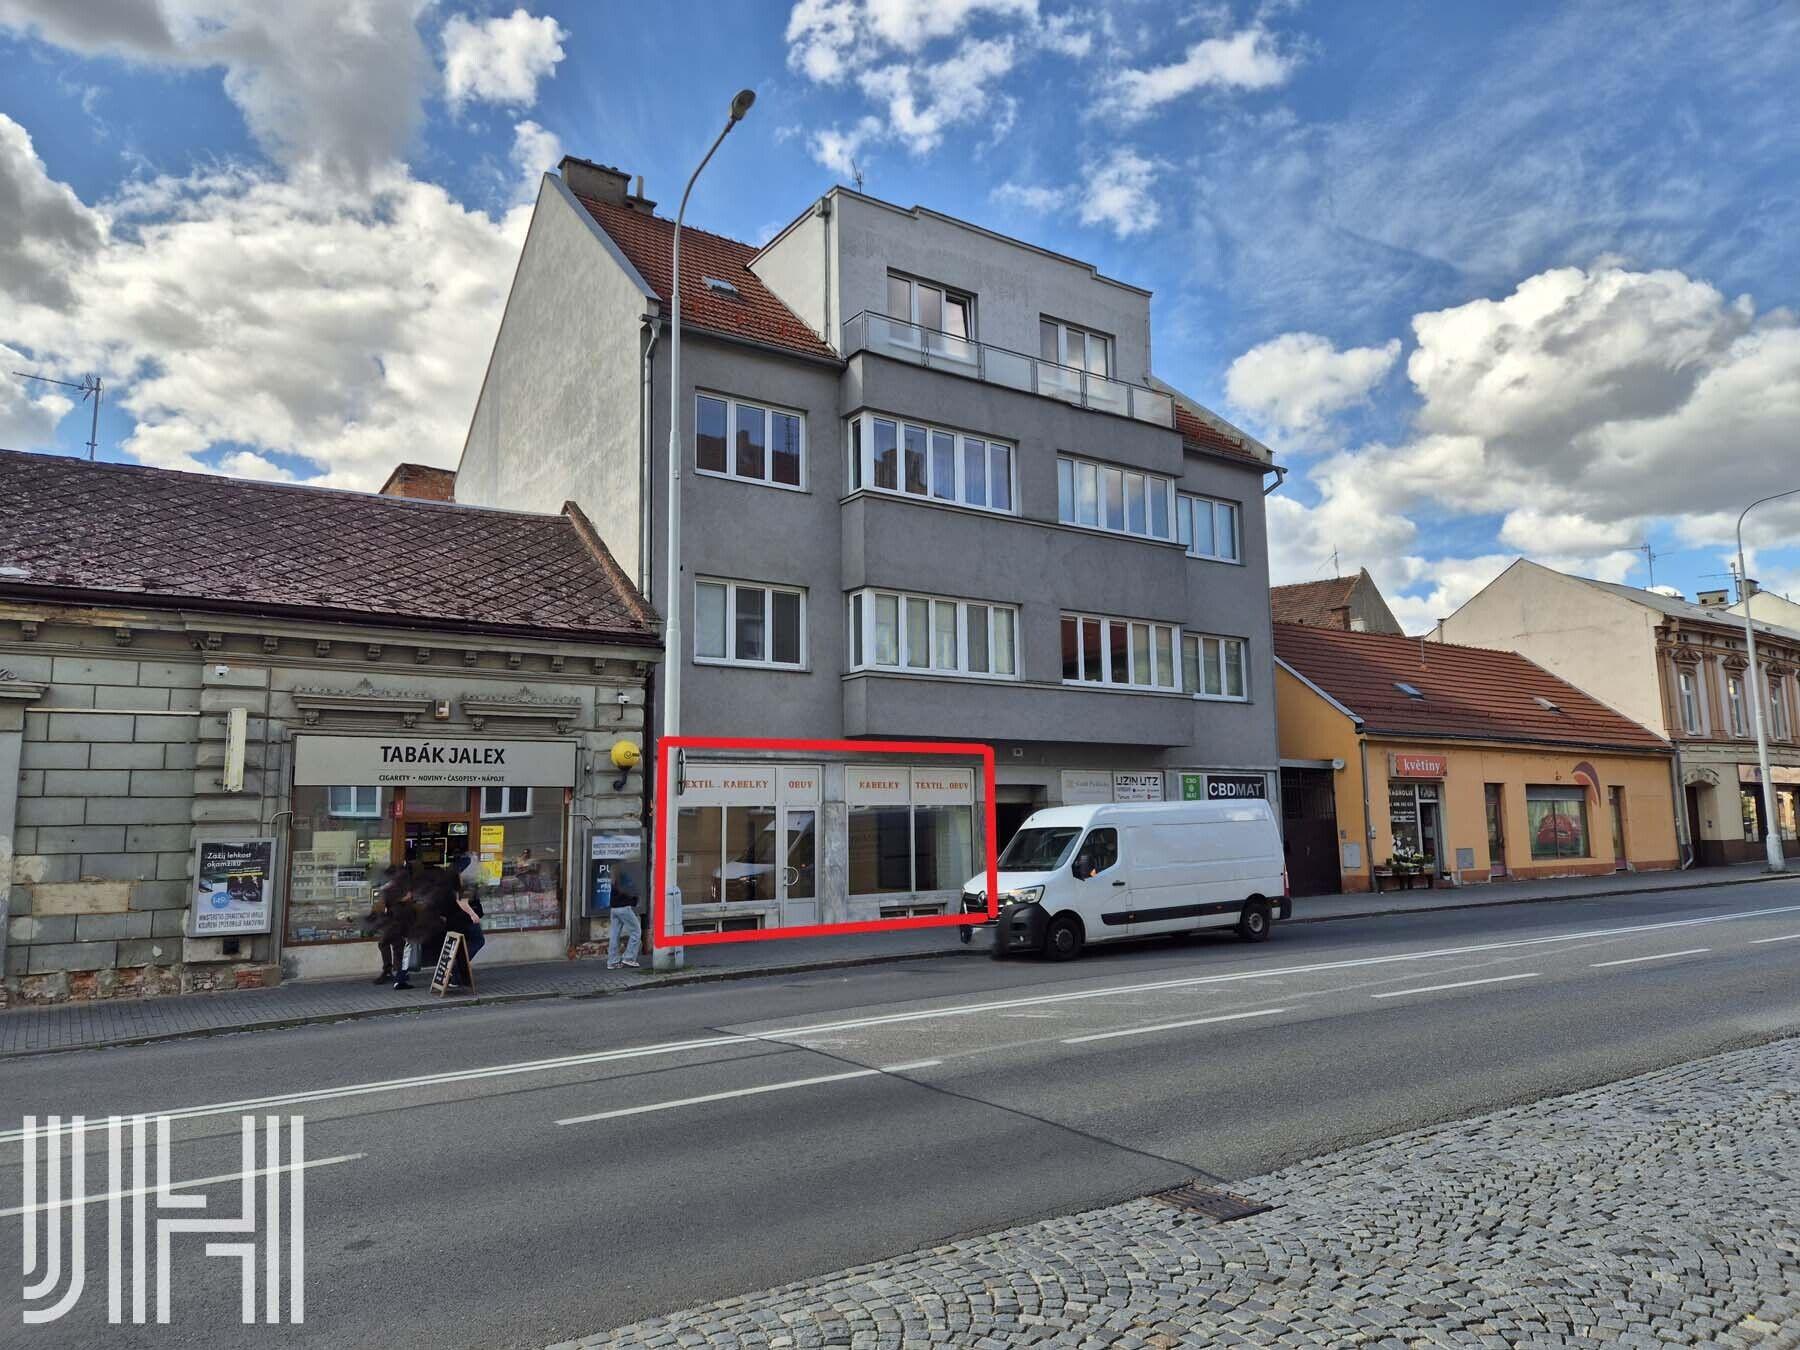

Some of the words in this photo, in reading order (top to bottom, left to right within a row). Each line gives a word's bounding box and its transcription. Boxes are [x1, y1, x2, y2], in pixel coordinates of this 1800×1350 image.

[380, 743, 444, 764] TABÁK
[448, 748, 505, 764] JALEX
[1404, 759, 1441, 772] květiny
[447, 774, 478, 782] ČASOPISY
[481, 774, 505, 783] NÁPOJE
[723, 780, 769, 789] KABELKY
[788, 780, 813, 789] OBUV
[859, 781, 900, 789] KABELKY
[915, 781, 944, 790] TEXTIL
[1209, 783, 1261, 797] CBDMAT
[207, 852, 226, 861] Zažij
[227, 850, 252, 860] lehkost
